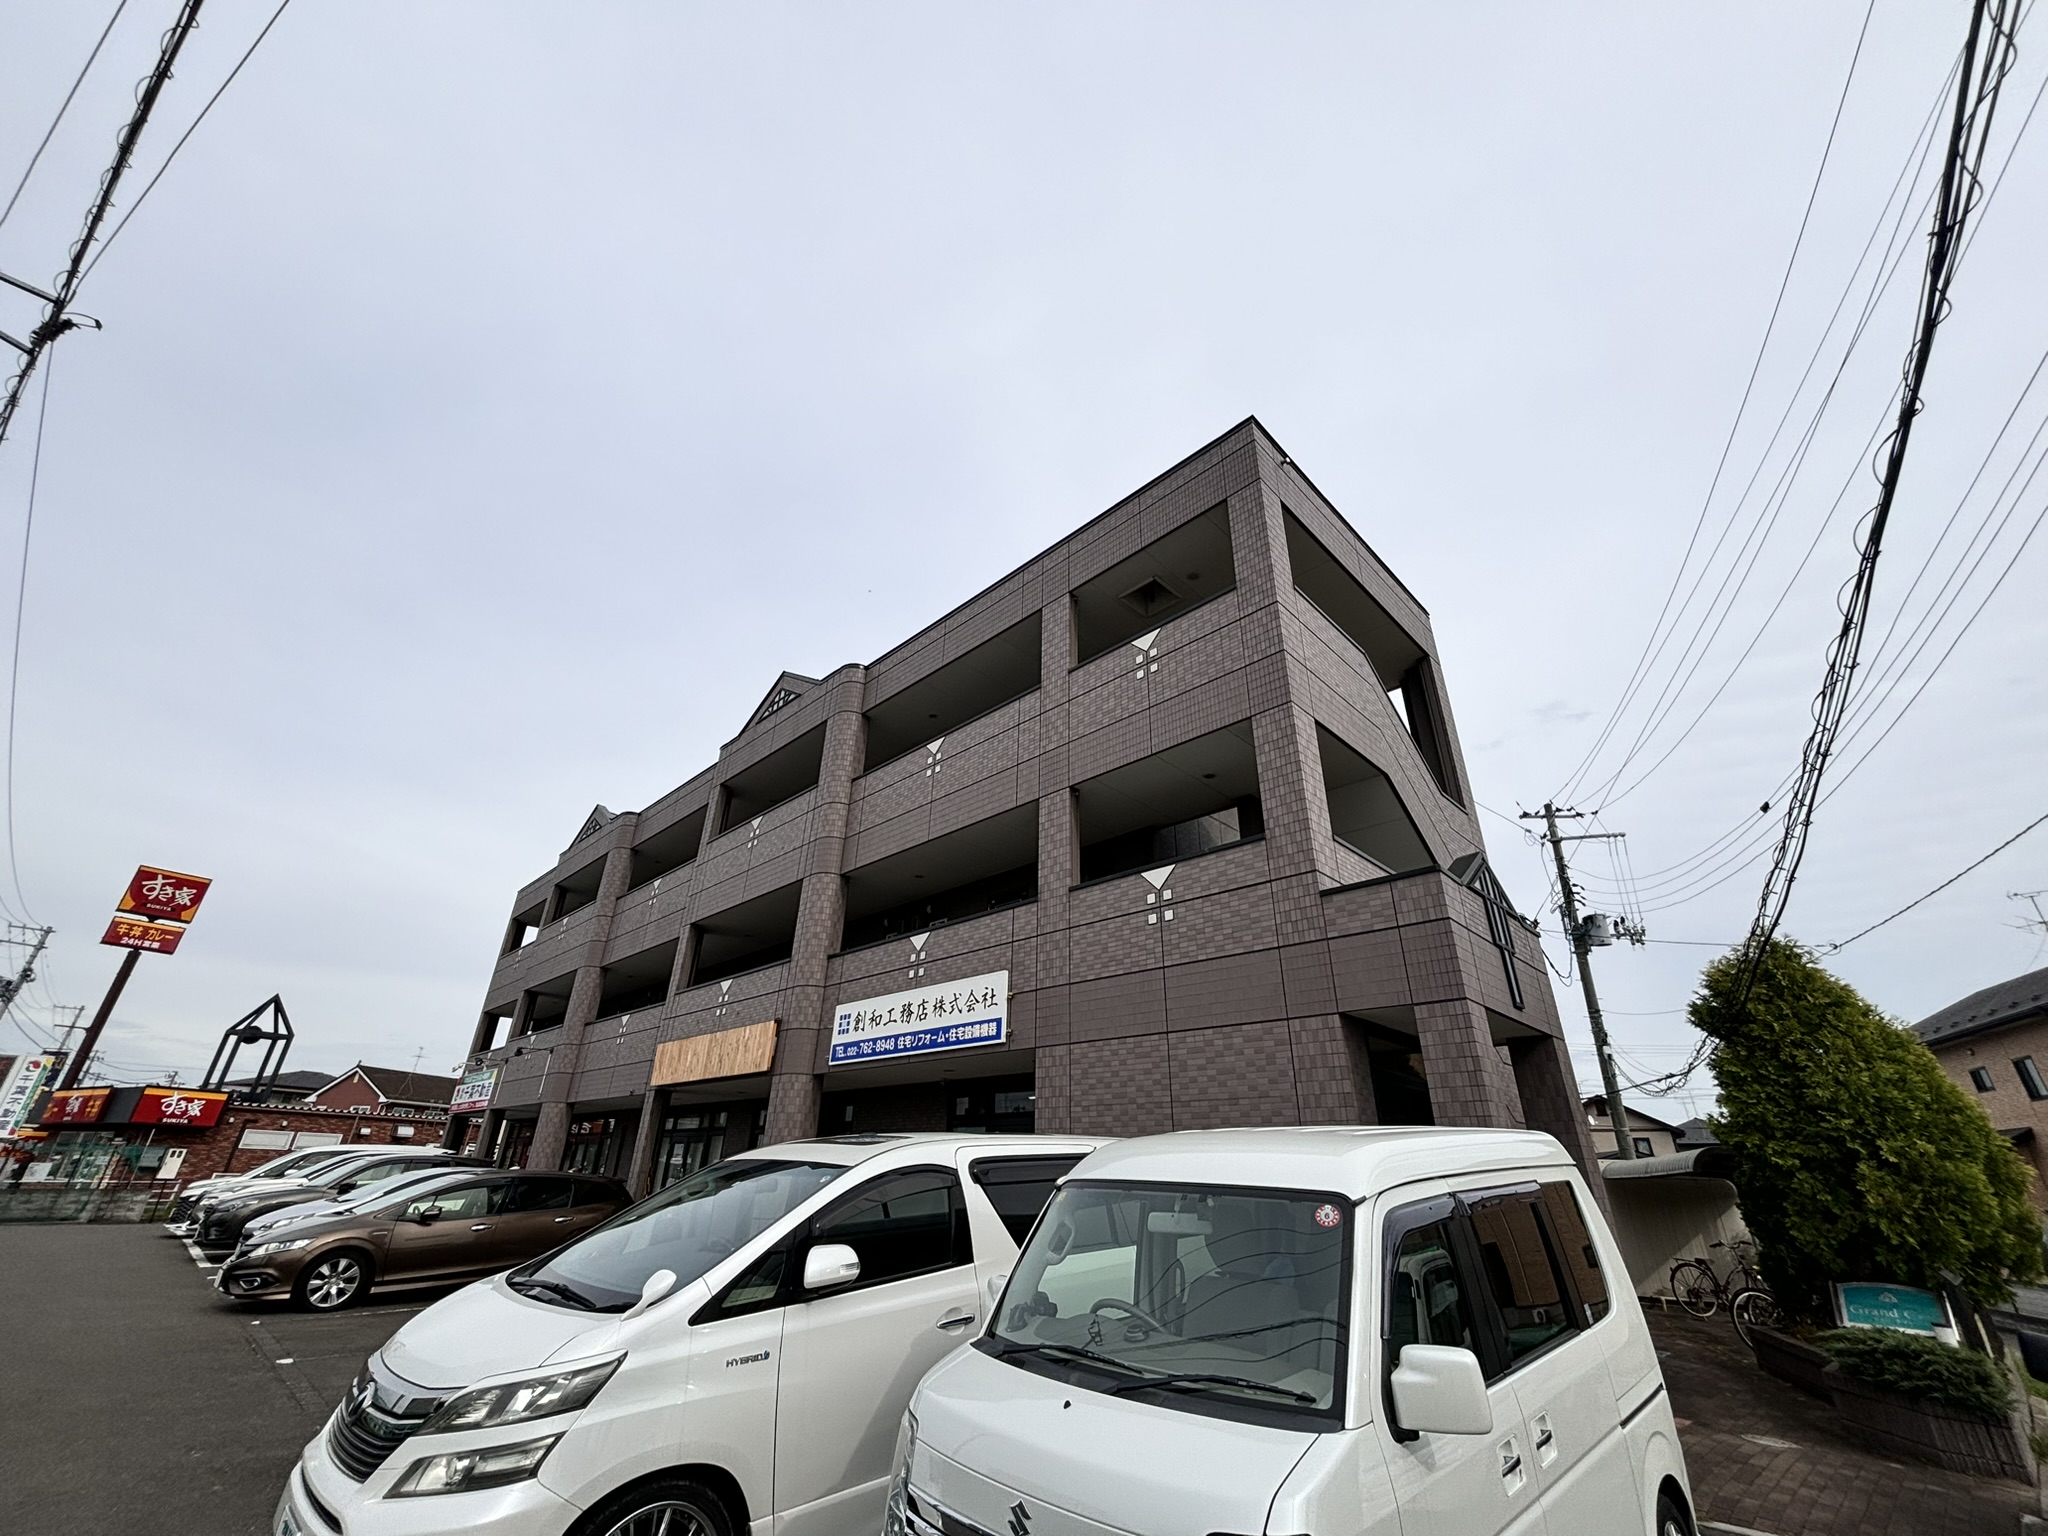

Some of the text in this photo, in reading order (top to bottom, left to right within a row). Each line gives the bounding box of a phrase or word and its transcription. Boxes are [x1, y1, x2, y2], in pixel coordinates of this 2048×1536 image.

[141, 874, 198, 907] すき家
[146, 903, 172, 912] SUKIYA
[116, 923, 175, 941] 牛丼 カレー
[852, 986, 999, 1034] 創和工務店株式会社
[160, 1090, 207, 1119] すき家
[1849, 1304, 1899, 1319] Grand
[725, 1352, 764, 1369] HYBRID
